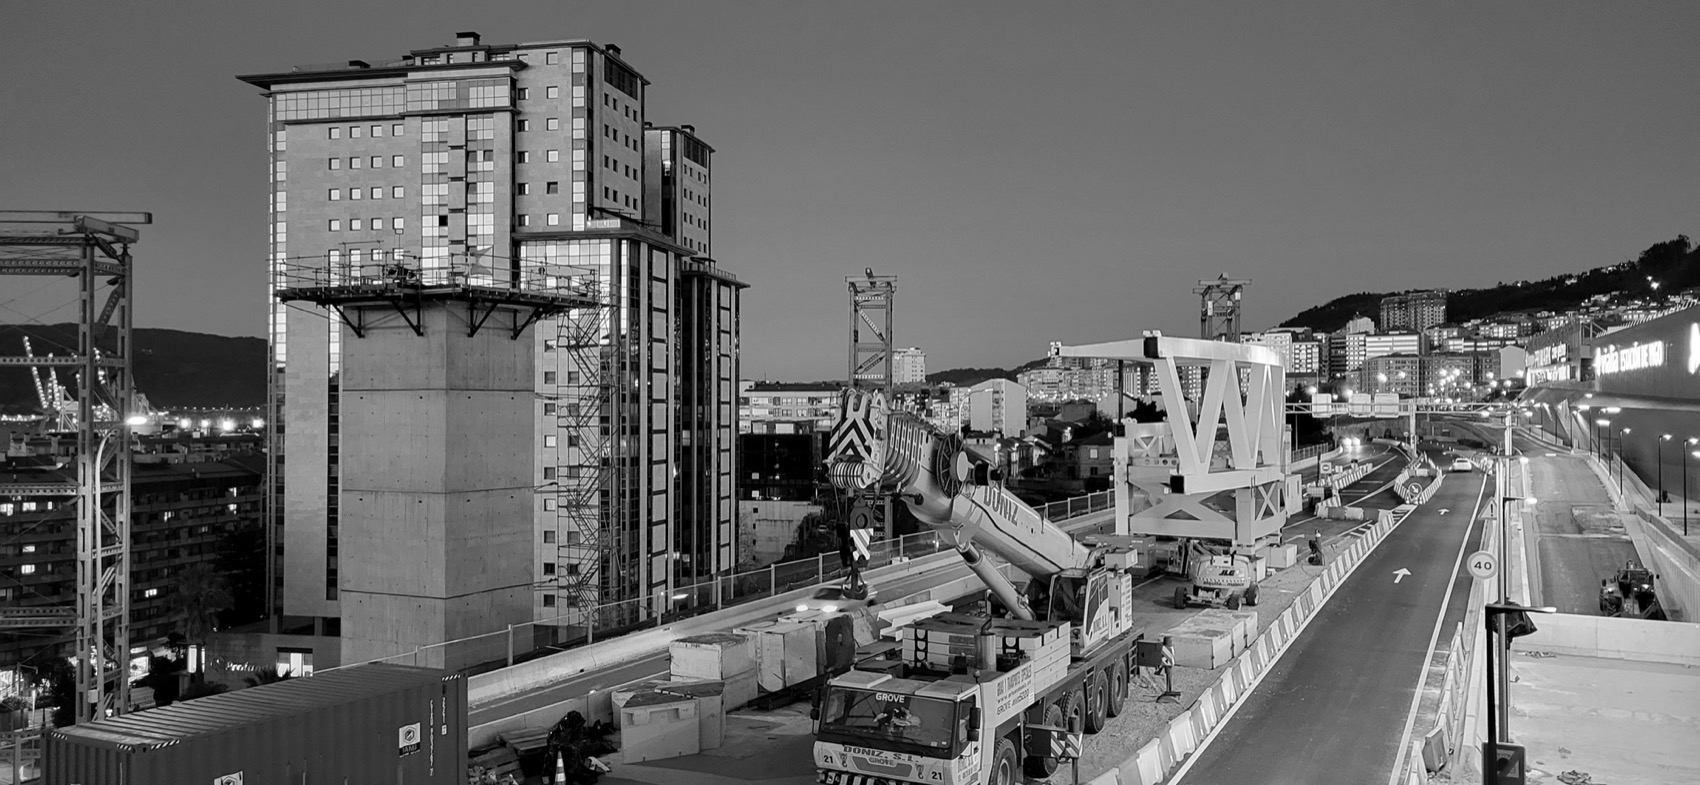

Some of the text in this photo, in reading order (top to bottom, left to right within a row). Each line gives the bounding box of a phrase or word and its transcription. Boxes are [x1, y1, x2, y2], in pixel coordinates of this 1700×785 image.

[1474, 561, 1492, 570] 40
[875, 692, 905, 704] GROVE
[823, 754, 834, 764] 21
[869, 757, 894, 766] GROVE
[931, 771, 943, 781] 21
